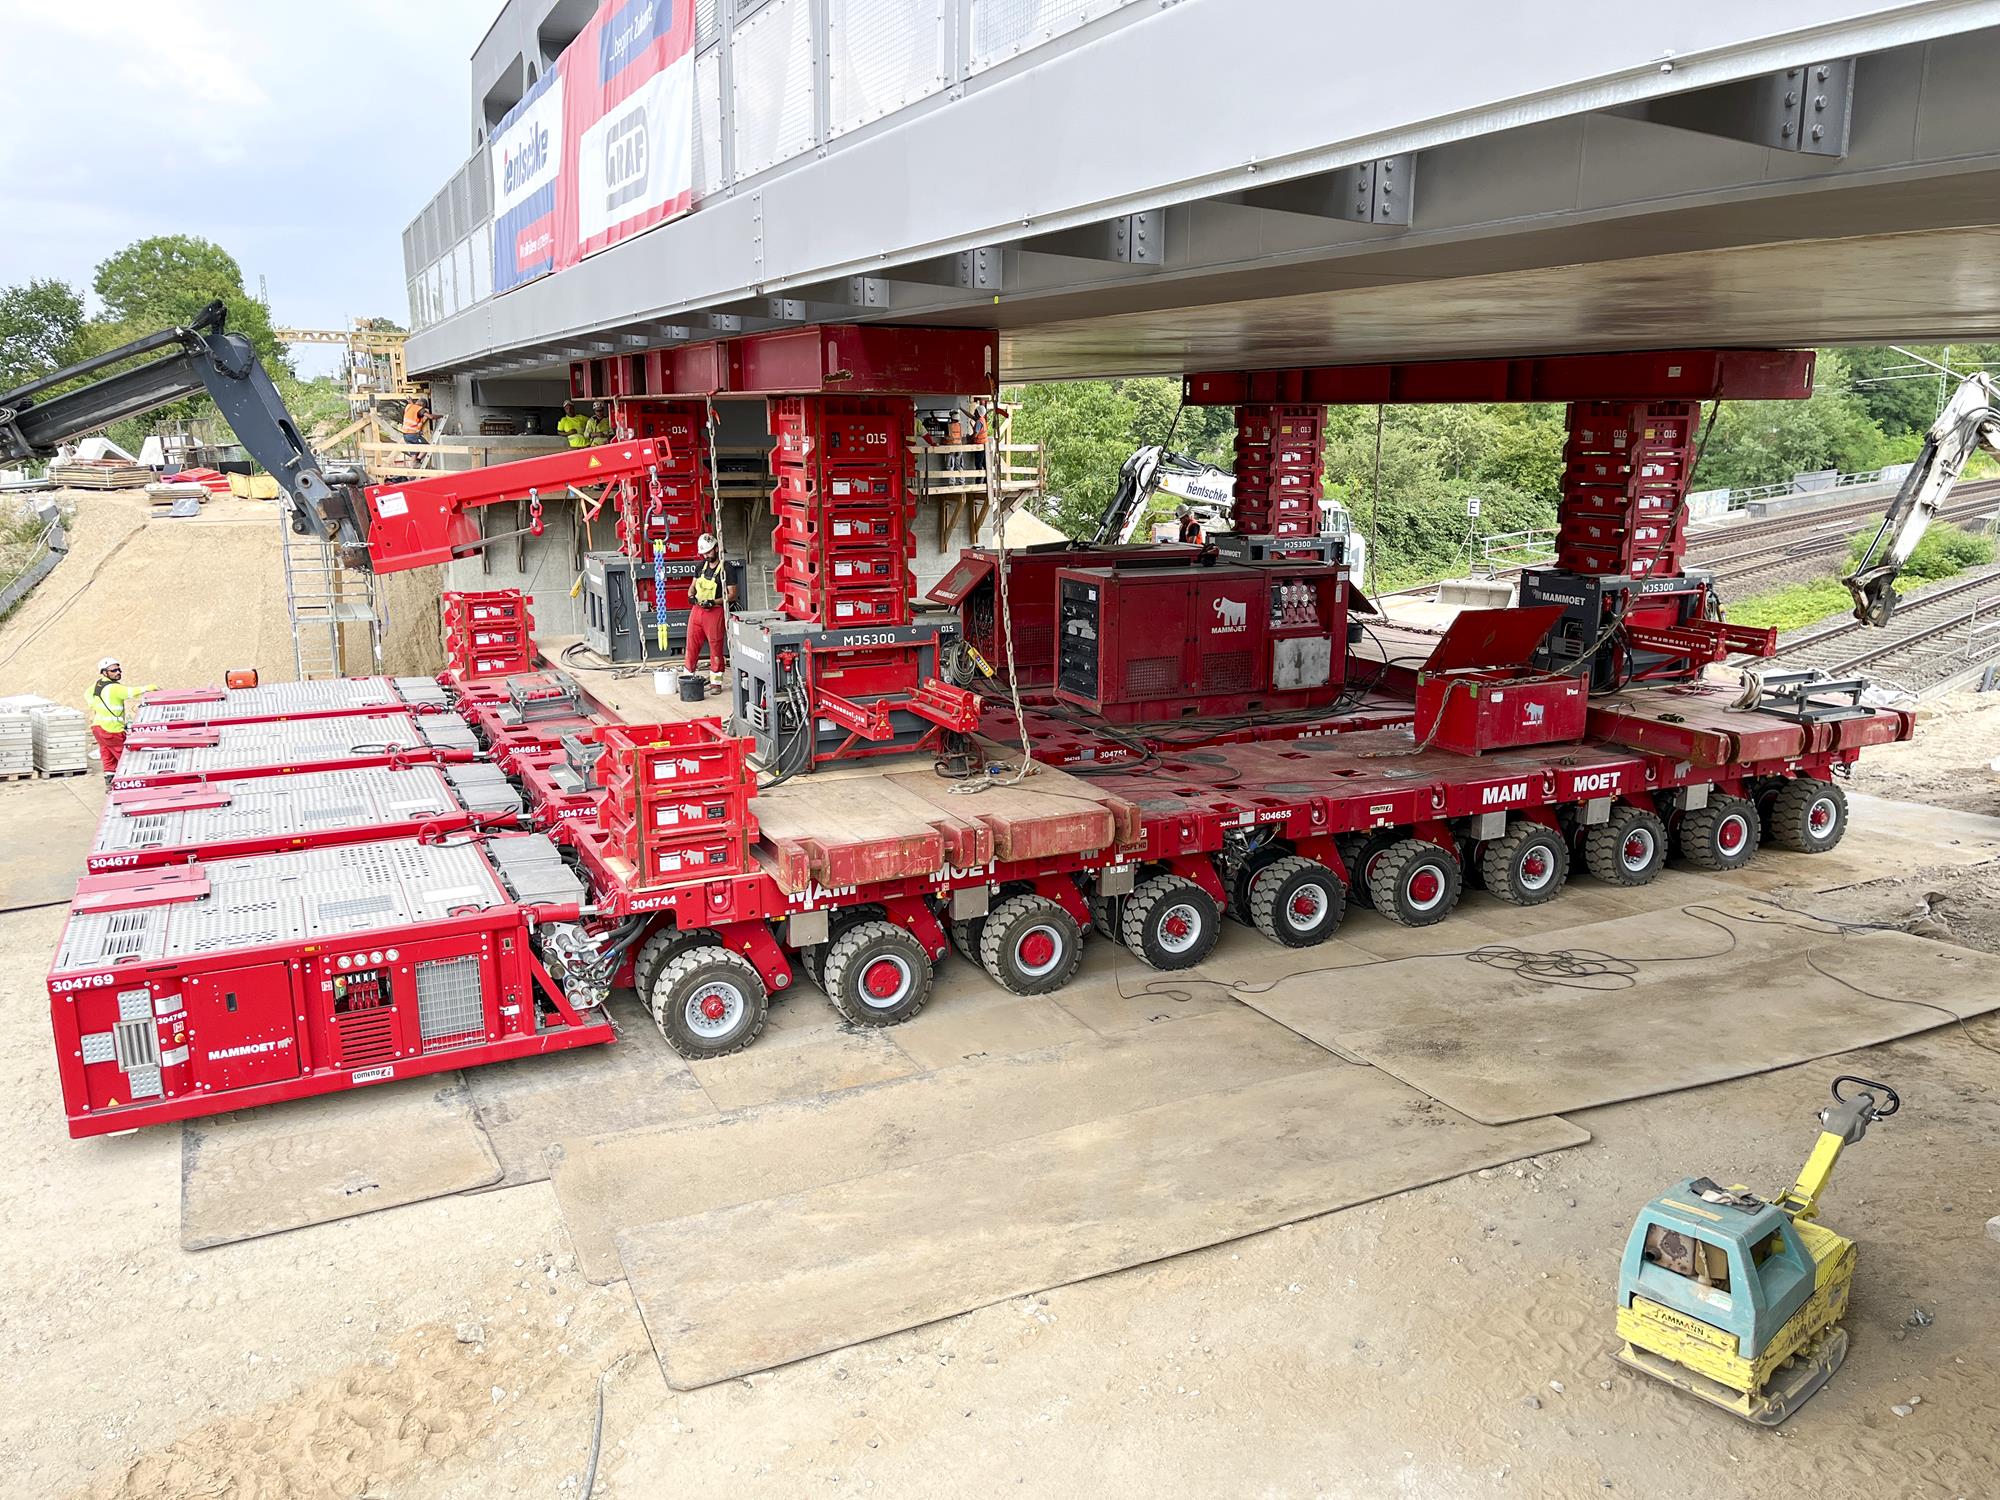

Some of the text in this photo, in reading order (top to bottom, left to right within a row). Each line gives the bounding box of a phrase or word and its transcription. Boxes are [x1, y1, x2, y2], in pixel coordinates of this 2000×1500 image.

[672, 426, 687, 434] 014
[1613, 429, 1628, 438] 016
[1664, 429, 1677, 439] 016
[866, 433, 887, 444] 015
[1469, 501, 1478, 514] E
[662, 565, 696, 574] JS300
[1642, 582, 1674, 593] MJS300
[1542, 592, 1586, 606] MAMMOET
[941, 625, 954, 633] 015
[1211, 625, 1247, 634] MAMMOET
[843, 633, 896, 647] MJS300
[1633, 633, 1707, 649] www.mammoet.com
[509, 746, 541, 754] 304661
[1482, 772, 1621, 805] MAM MOET
[558, 807, 597, 818] 304745
[1260, 809, 1292, 821] 304655
[90, 855, 139, 869] 304677
[630, 895, 677, 911] 304744
[52, 974, 115, 992] 304769
[157, 1011, 188, 1025] 304769
[208, 1041, 276, 1060] MAMMOET
